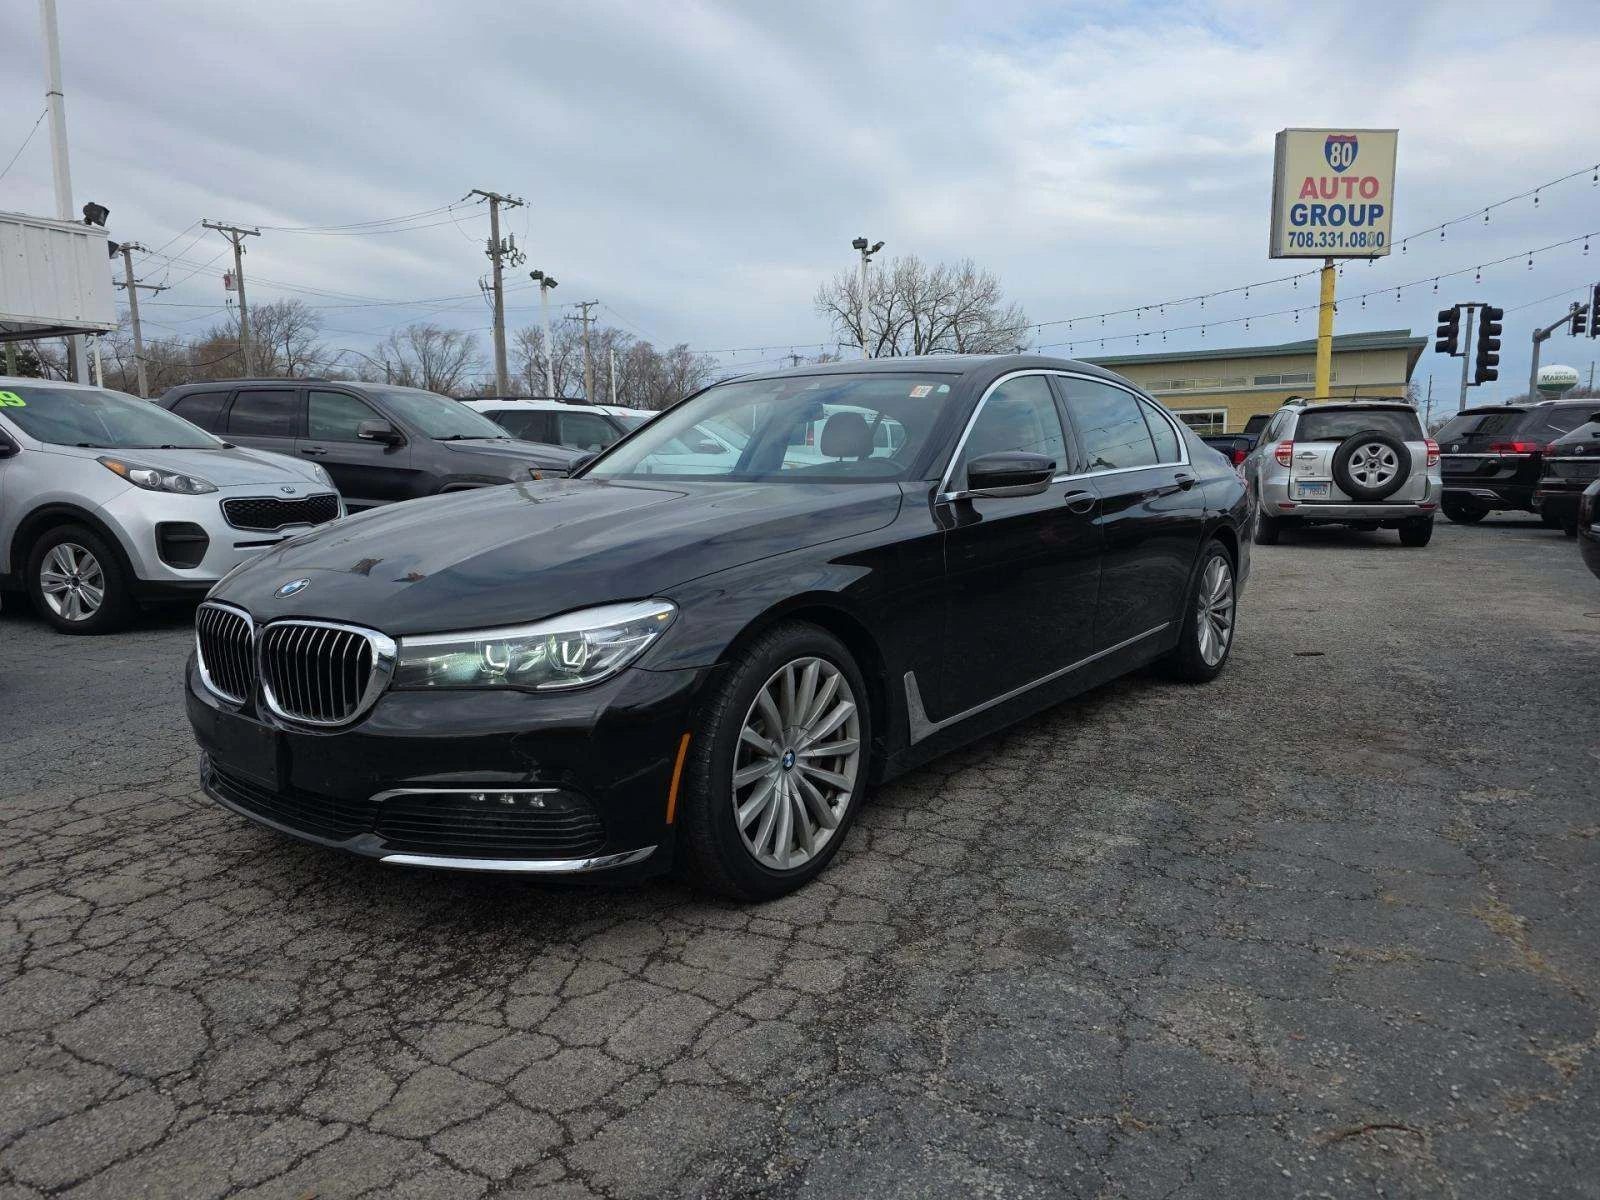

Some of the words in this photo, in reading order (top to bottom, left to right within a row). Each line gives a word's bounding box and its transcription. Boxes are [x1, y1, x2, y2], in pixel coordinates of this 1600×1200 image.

[1330, 142, 1353, 167] 80
[1299, 176, 1380, 199] AUTO
[1290, 203, 1384, 226] GROUP
